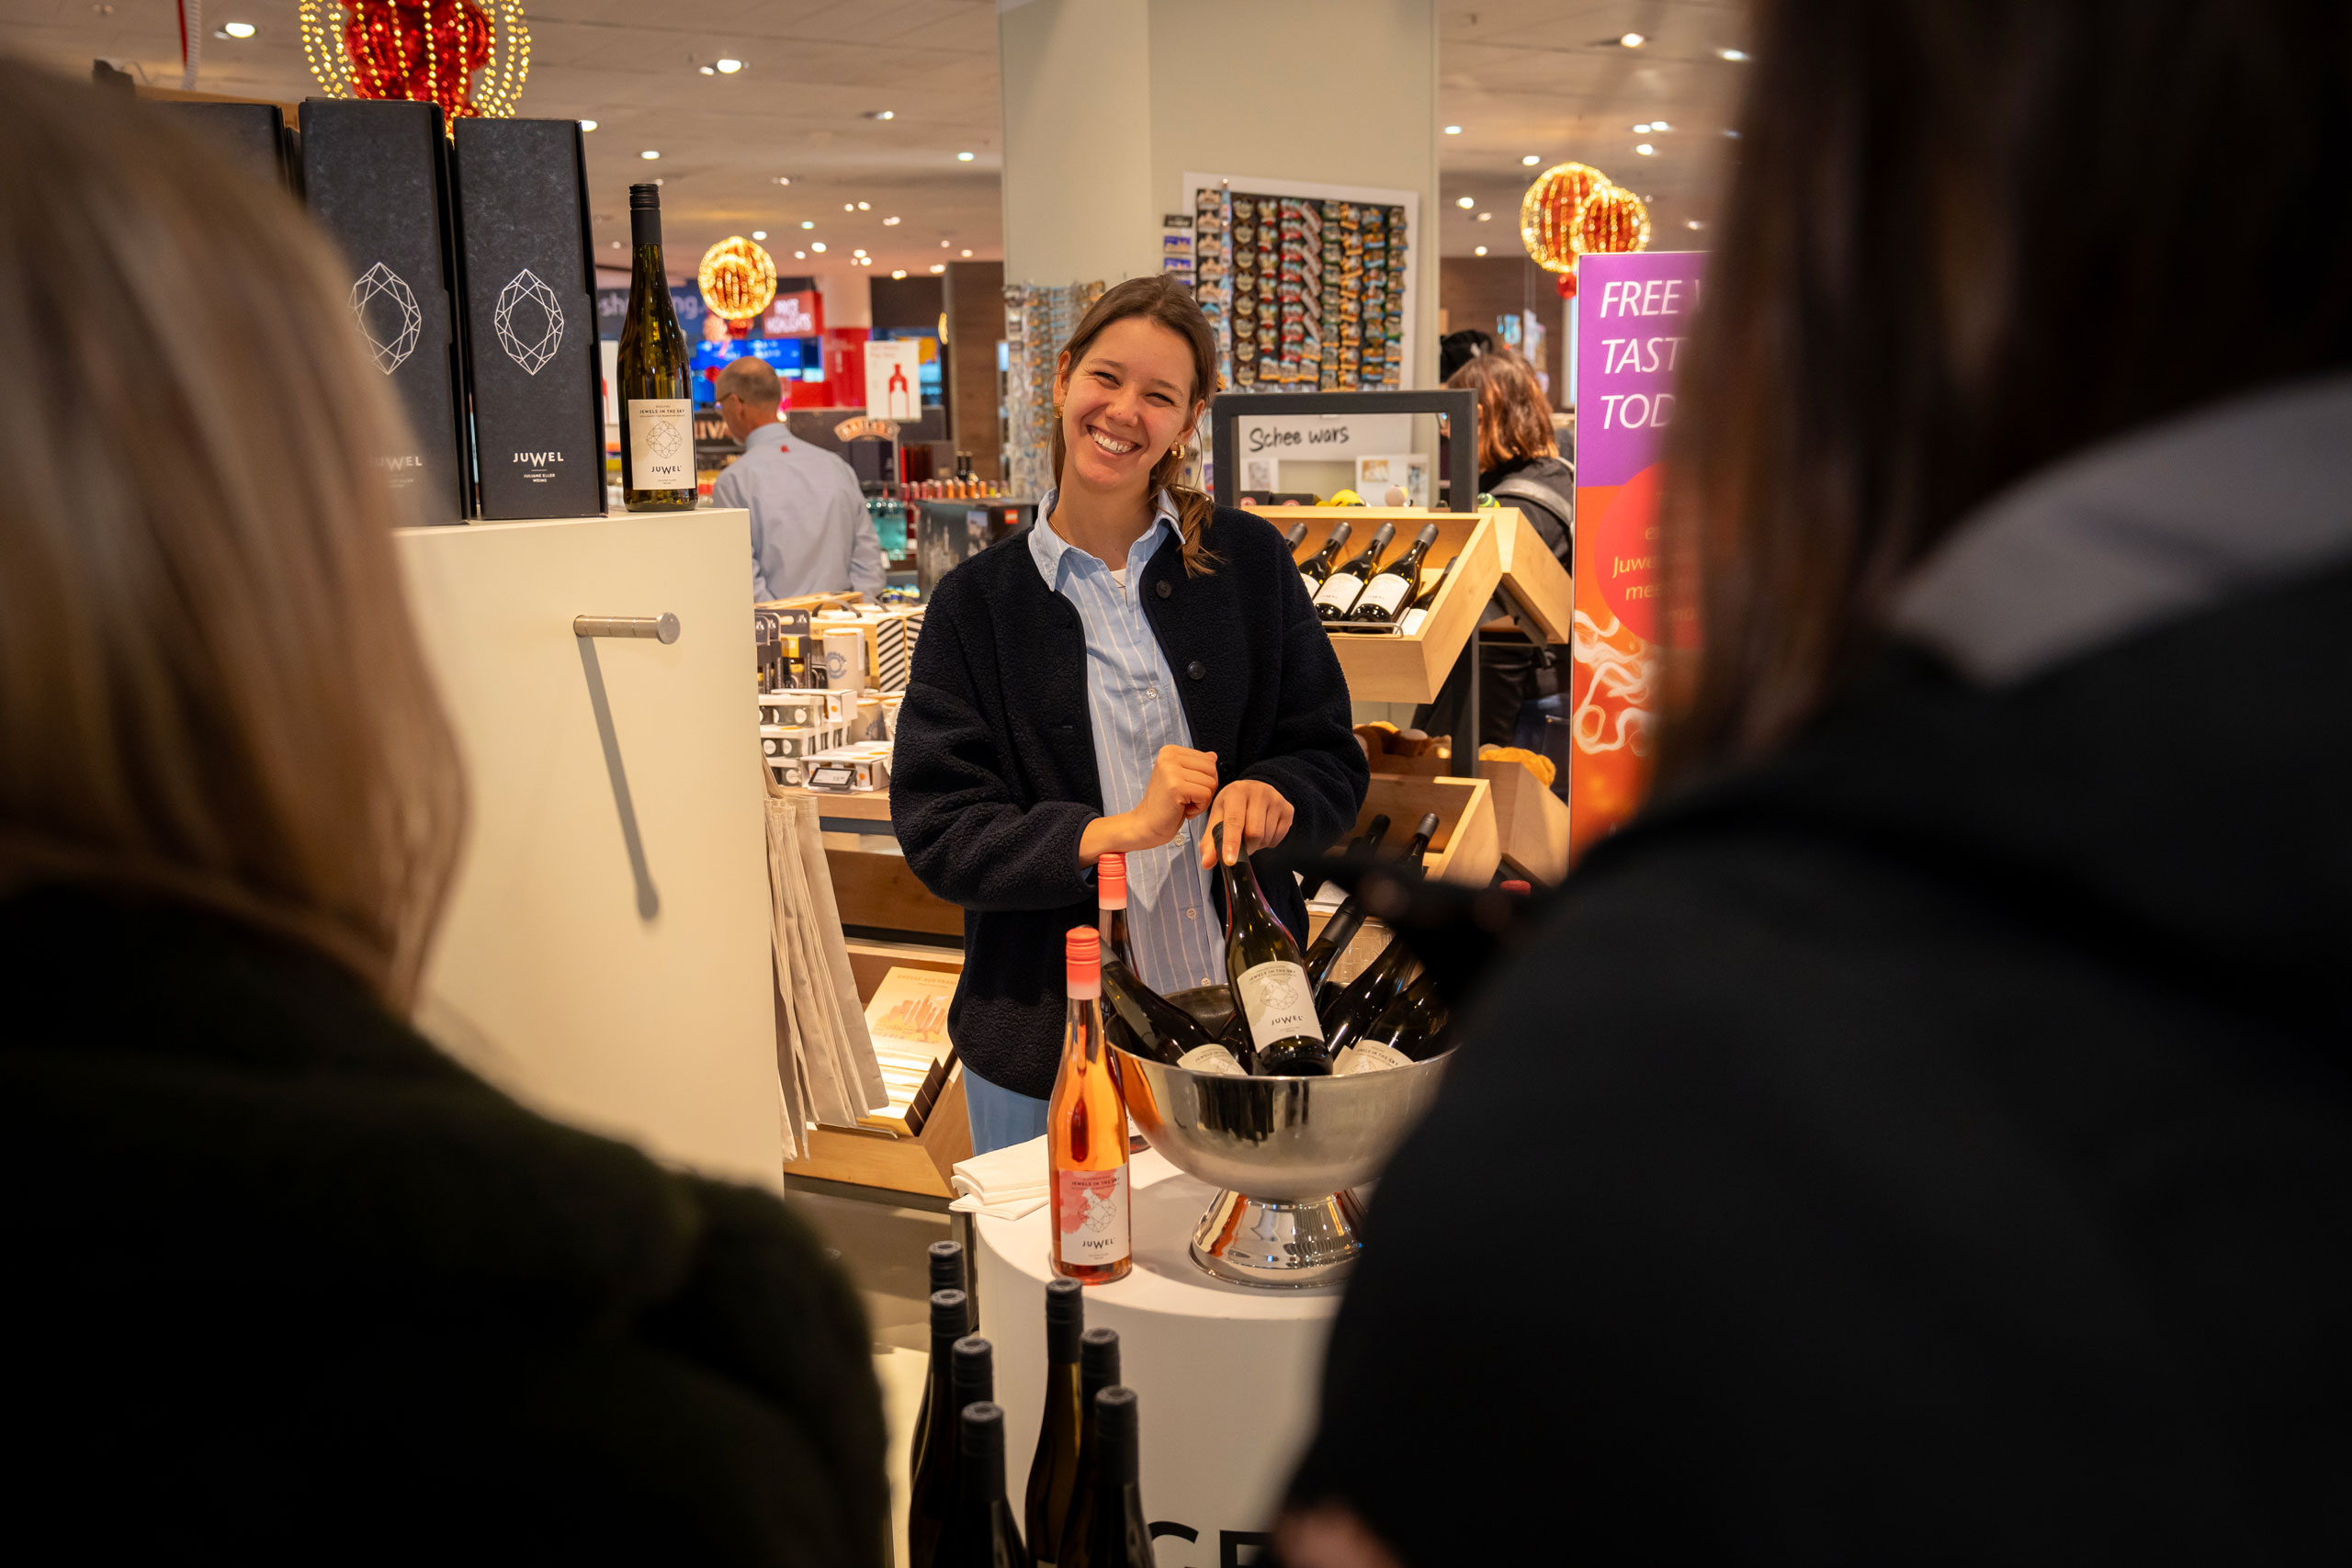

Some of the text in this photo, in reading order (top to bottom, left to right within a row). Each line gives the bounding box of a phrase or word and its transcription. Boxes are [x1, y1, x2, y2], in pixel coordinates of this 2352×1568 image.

[1600, 279, 1683, 319] FREE
[1601, 337, 1688, 375] TAST
[1600, 393, 1677, 430] TOD
[1249, 426, 1349, 453] Schee wars
[513, 452, 565, 468] JUWEL
[651, 466, 681, 475] JUWEL
[1611, 556, 1657, 580] Juwe
[1271, 1015, 1303, 1026] JUWEL
[1082, 1237, 1114, 1249] JUWEL
